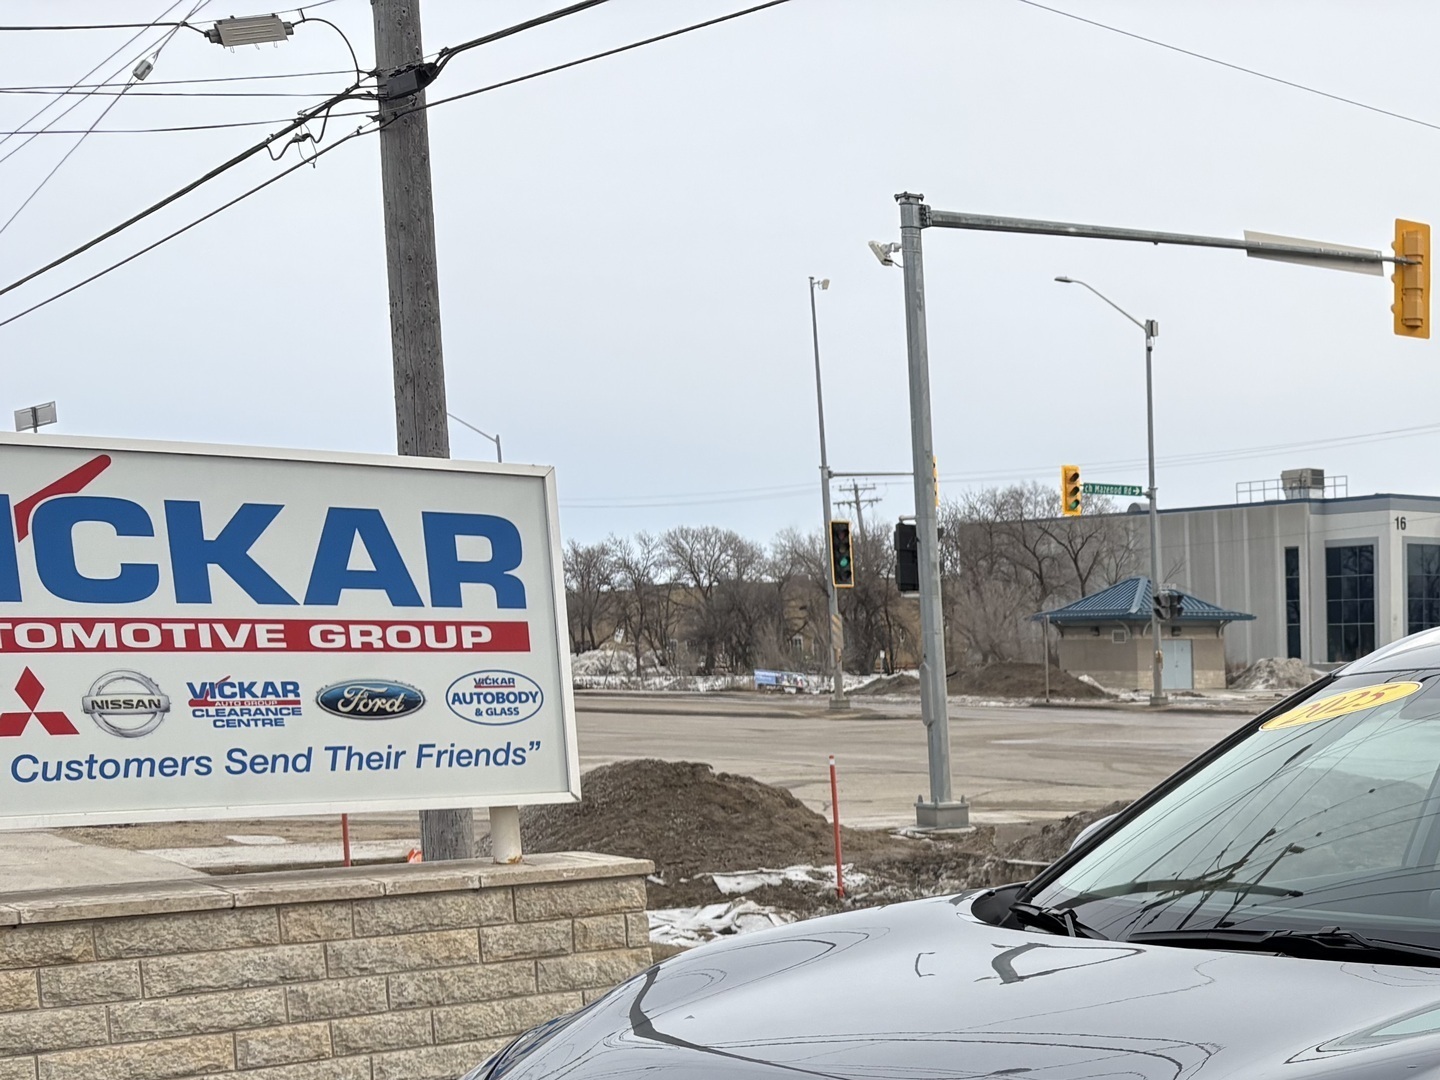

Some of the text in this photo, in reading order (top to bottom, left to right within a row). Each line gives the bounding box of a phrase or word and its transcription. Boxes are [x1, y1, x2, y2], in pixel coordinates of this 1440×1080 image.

[1094, 485, 1122, 495] Mazenod
[1123, 487, 1132, 495] Rd
[1394, 516, 1407, 531] 16
[308, 623, 493, 649] GROUP
[473, 677, 516, 686] VICKAR
[186, 680, 301, 700] VICKAR
[91, 698, 162, 711] NISSAN
[337, 685, 407, 714] Ford
[451, 691, 539, 706] AUTOBODY
[1277, 684, 1402, 726] 2025
[191, 706, 303, 718] CLEARANCE
[475, 706, 520, 717] & GLASS
[213, 718, 286, 728] CENTRE
[11, 753, 213, 784] Customers
[225, 747, 314, 775] Send
[324, 744, 407, 772] Their
